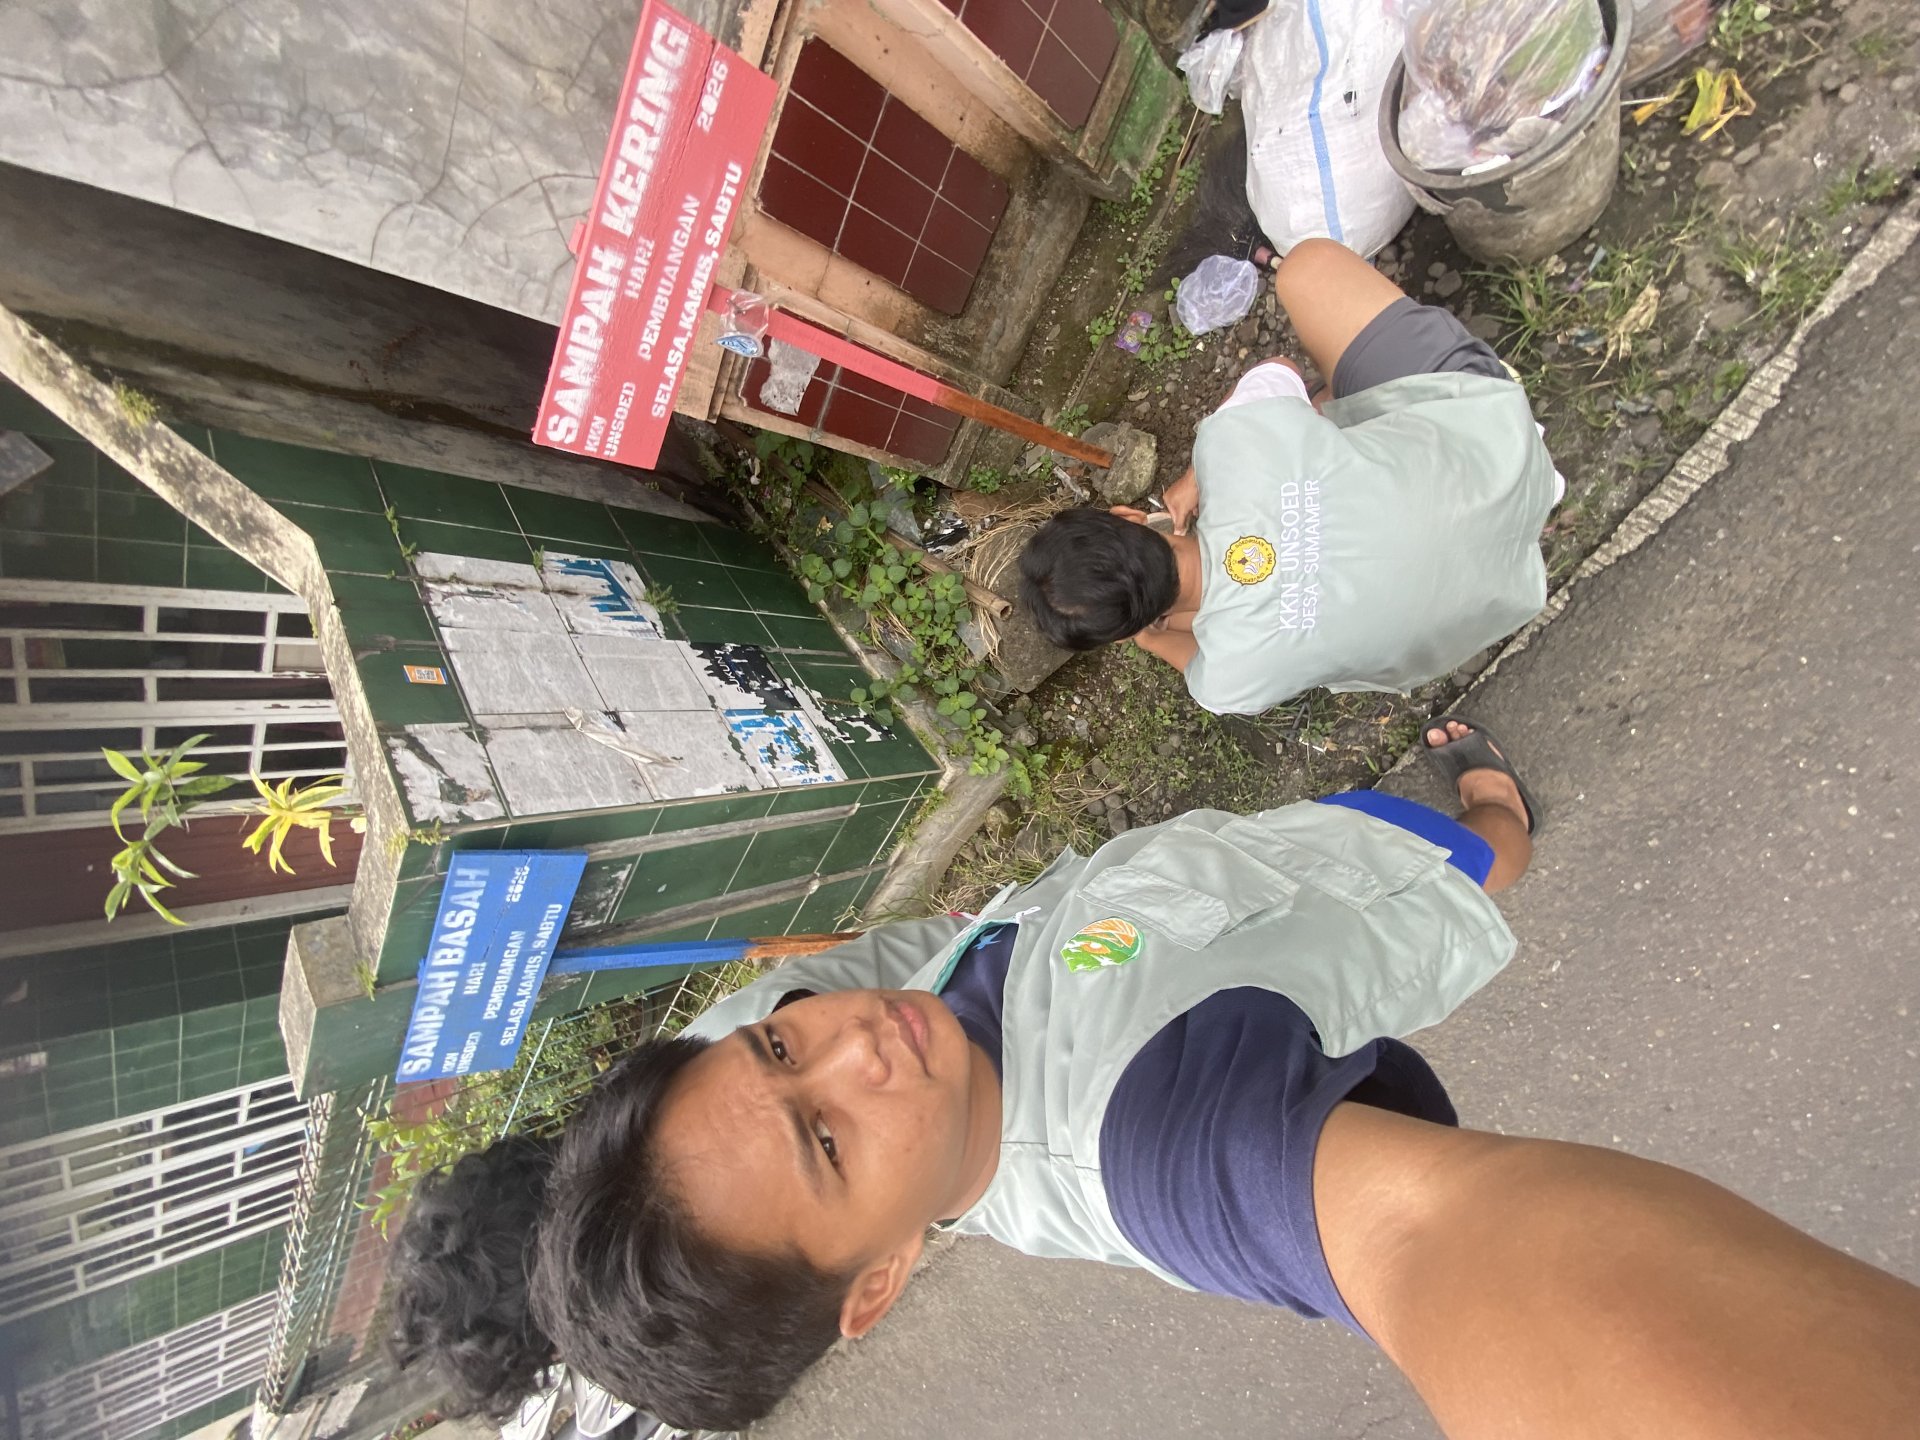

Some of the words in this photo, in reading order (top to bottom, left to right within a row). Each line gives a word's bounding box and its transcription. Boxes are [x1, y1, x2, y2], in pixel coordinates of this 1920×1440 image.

[695, 60, 728, 133] 2026
[545, 245, 626, 443] SAMPAH
[601, 17, 691, 234] KERING
[705, 161, 743, 249] SABTU
[625, 236, 655, 299] HARI
[638, 194, 700, 361] PEMBUANGAN
[584, 416, 606, 452] KKN
[604, 382, 635, 458] UNSOED
[1280, 482, 1300, 571] UNSOED
[1304, 480, 1320, 574] SUMAMPIR
[1279, 583, 1299, 630] KKN
[1301, 583, 1318, 629] DESA
[532, 904, 563, 949] SABTU
[401, 971, 459, 1075] SAMPAH
[432, 867, 490, 966] BASAH
[463, 962, 487, 994] HARI
[483, 930, 525, 1020] PEMBUANGAN
[442, 1052, 460, 1073] KKN
[456, 1031, 482, 1074] UNSOED
